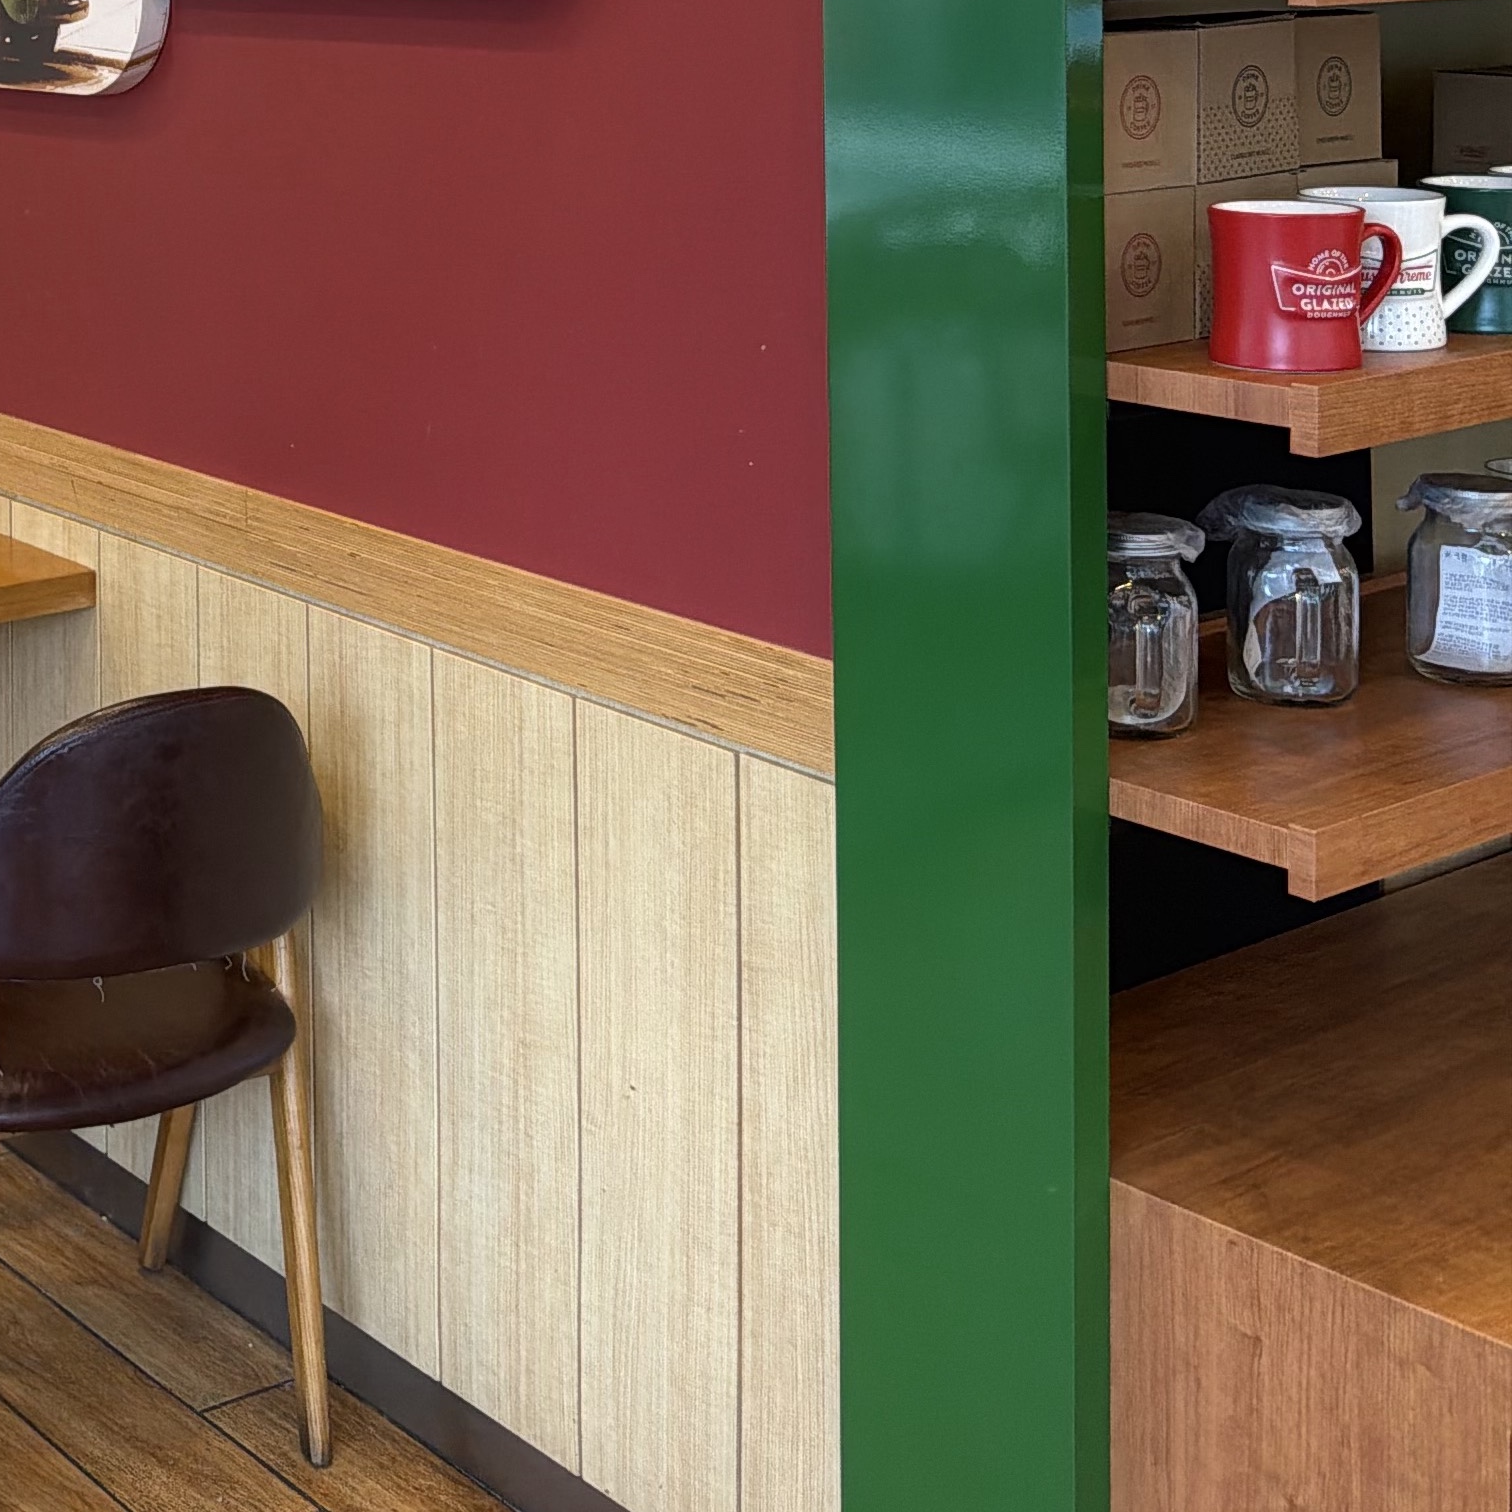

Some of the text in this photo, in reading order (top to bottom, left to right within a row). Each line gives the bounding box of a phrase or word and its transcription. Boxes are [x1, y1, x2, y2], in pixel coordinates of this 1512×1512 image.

[1307, 248, 1349, 271] HOME OF THE
[1291, 283, 1357, 295] ORIGINAL
[1300, 296, 1355, 311] GLAZED
